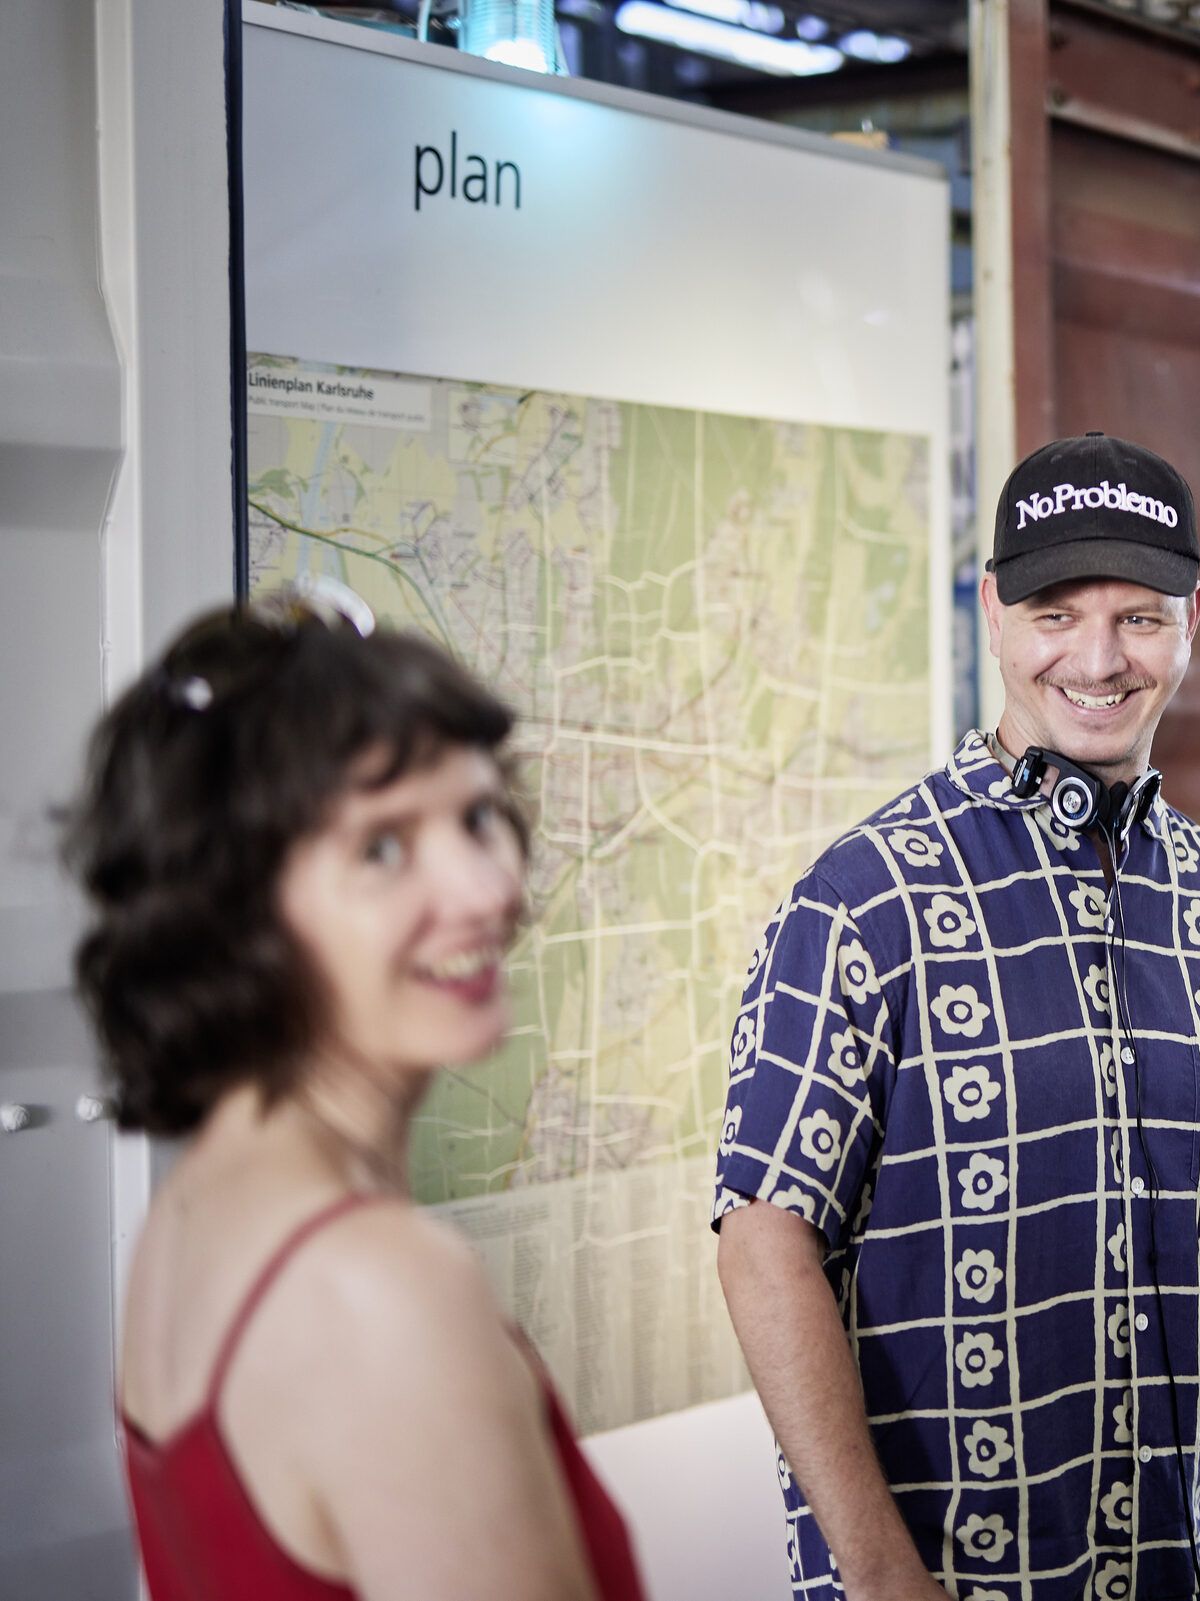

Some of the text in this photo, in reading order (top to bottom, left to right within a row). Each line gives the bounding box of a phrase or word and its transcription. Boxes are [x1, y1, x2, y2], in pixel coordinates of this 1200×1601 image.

[415, 130, 521, 211] plan
[249, 373, 374, 400] Linienplan Karlsruhe
